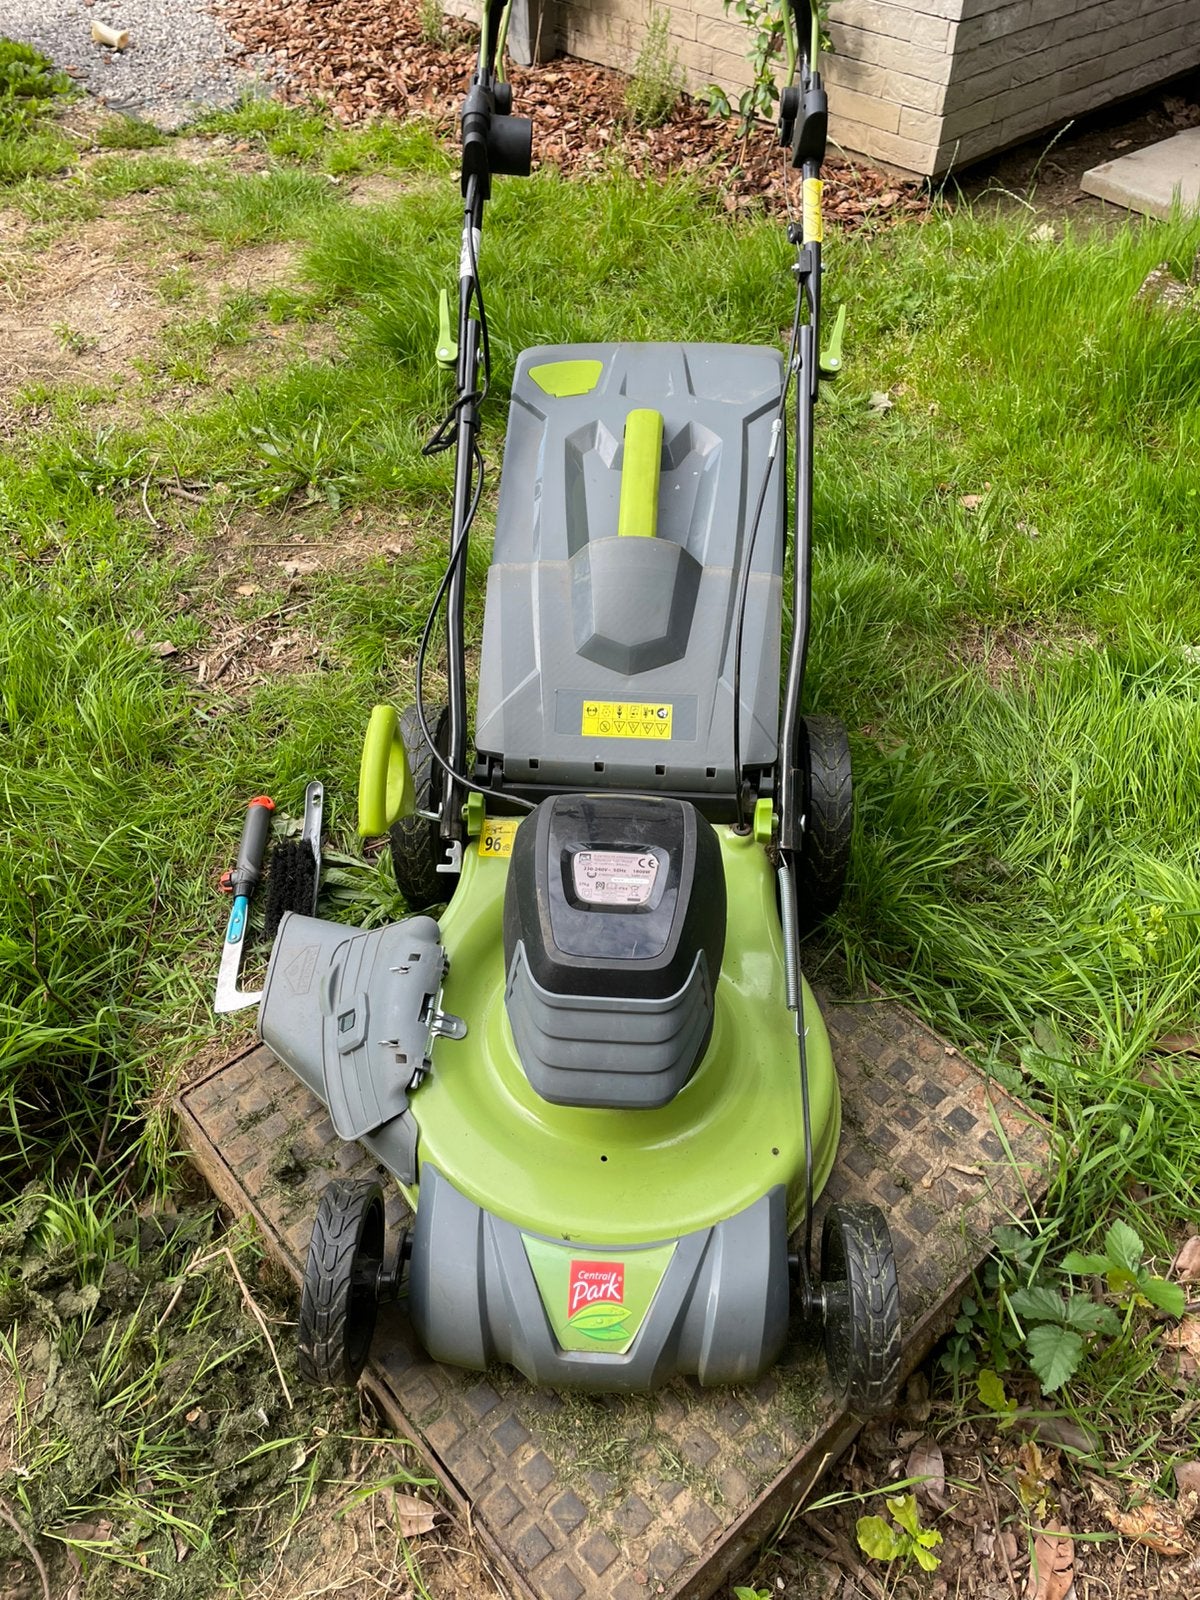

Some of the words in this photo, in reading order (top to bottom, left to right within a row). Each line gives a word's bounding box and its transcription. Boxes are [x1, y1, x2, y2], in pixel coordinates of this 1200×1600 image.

[485, 836, 501, 851] 96
[578, 1270, 612, 1281] Central
[573, 1273, 620, 1308] Park
